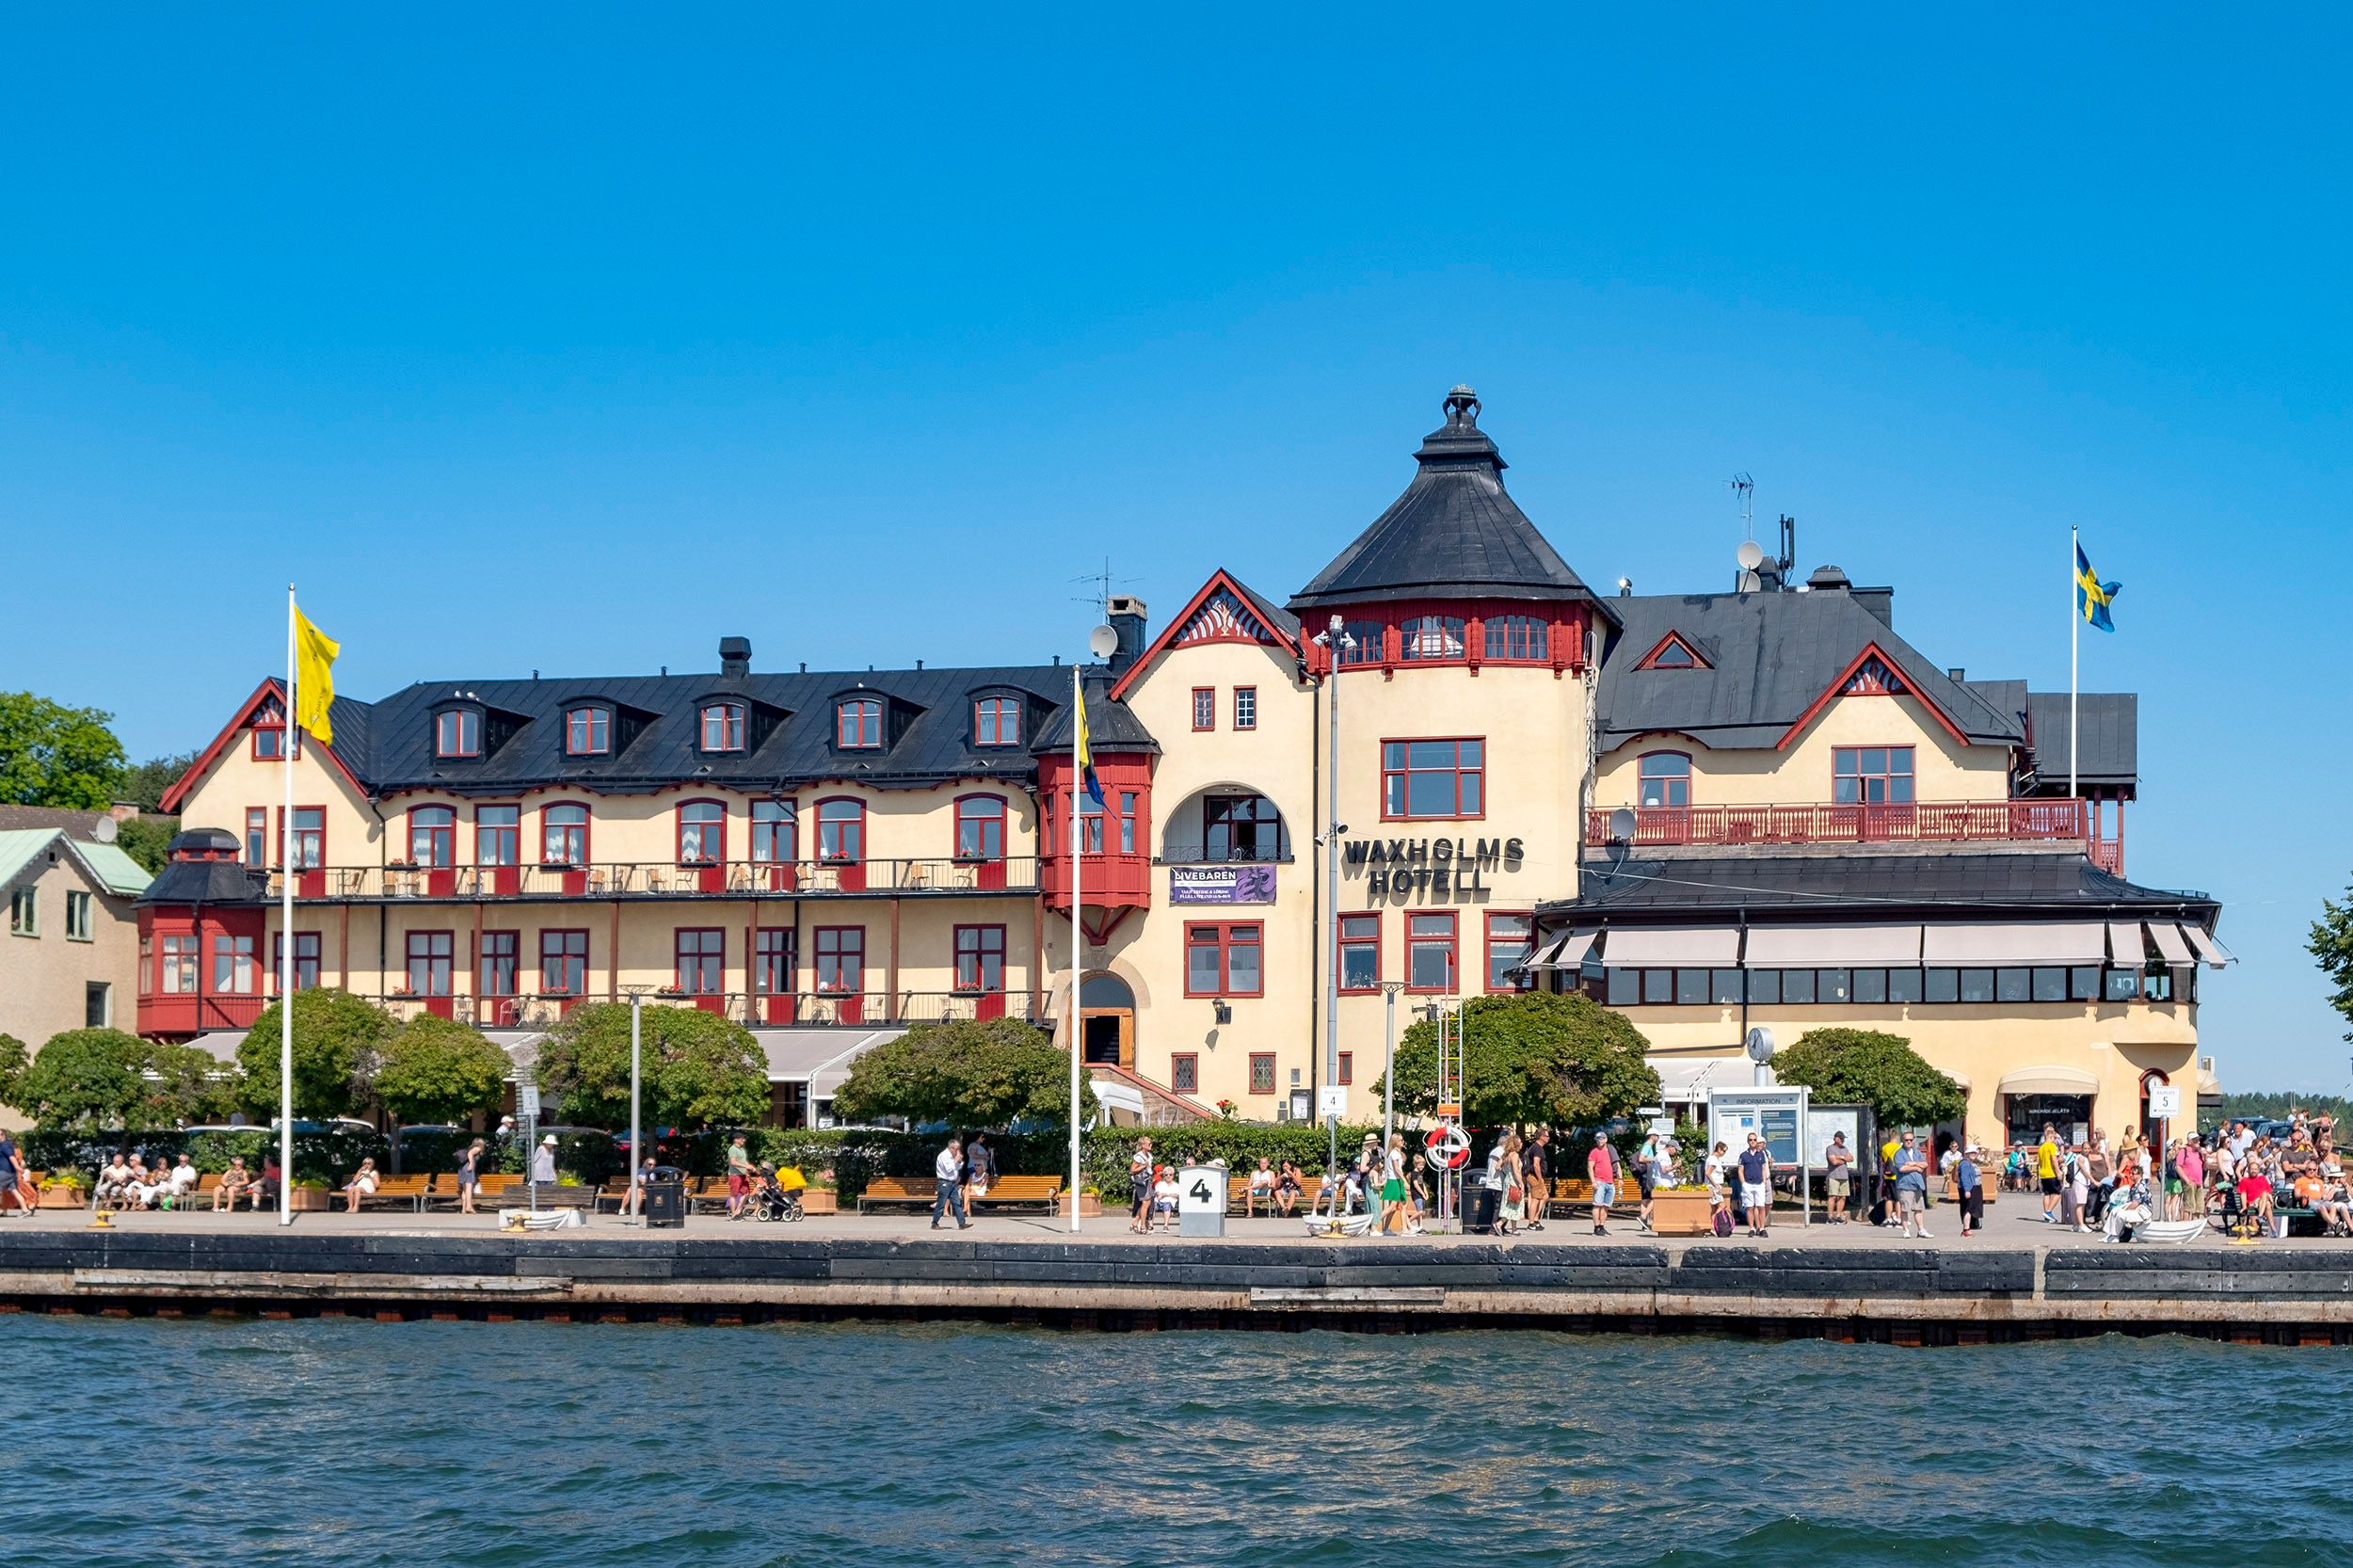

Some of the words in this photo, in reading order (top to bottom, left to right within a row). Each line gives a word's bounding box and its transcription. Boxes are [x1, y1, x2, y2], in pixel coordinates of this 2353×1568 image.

[1344, 838, 1524, 864] WAXHOLMS
[1175, 871, 1236, 880] LIVEBAREN
[1369, 868, 1491, 894] HOTELL
[1330, 1096, 1336, 1106] 4
[2162, 1096, 2169, 1107] 5
[1189, 1178, 1212, 1204] 4
